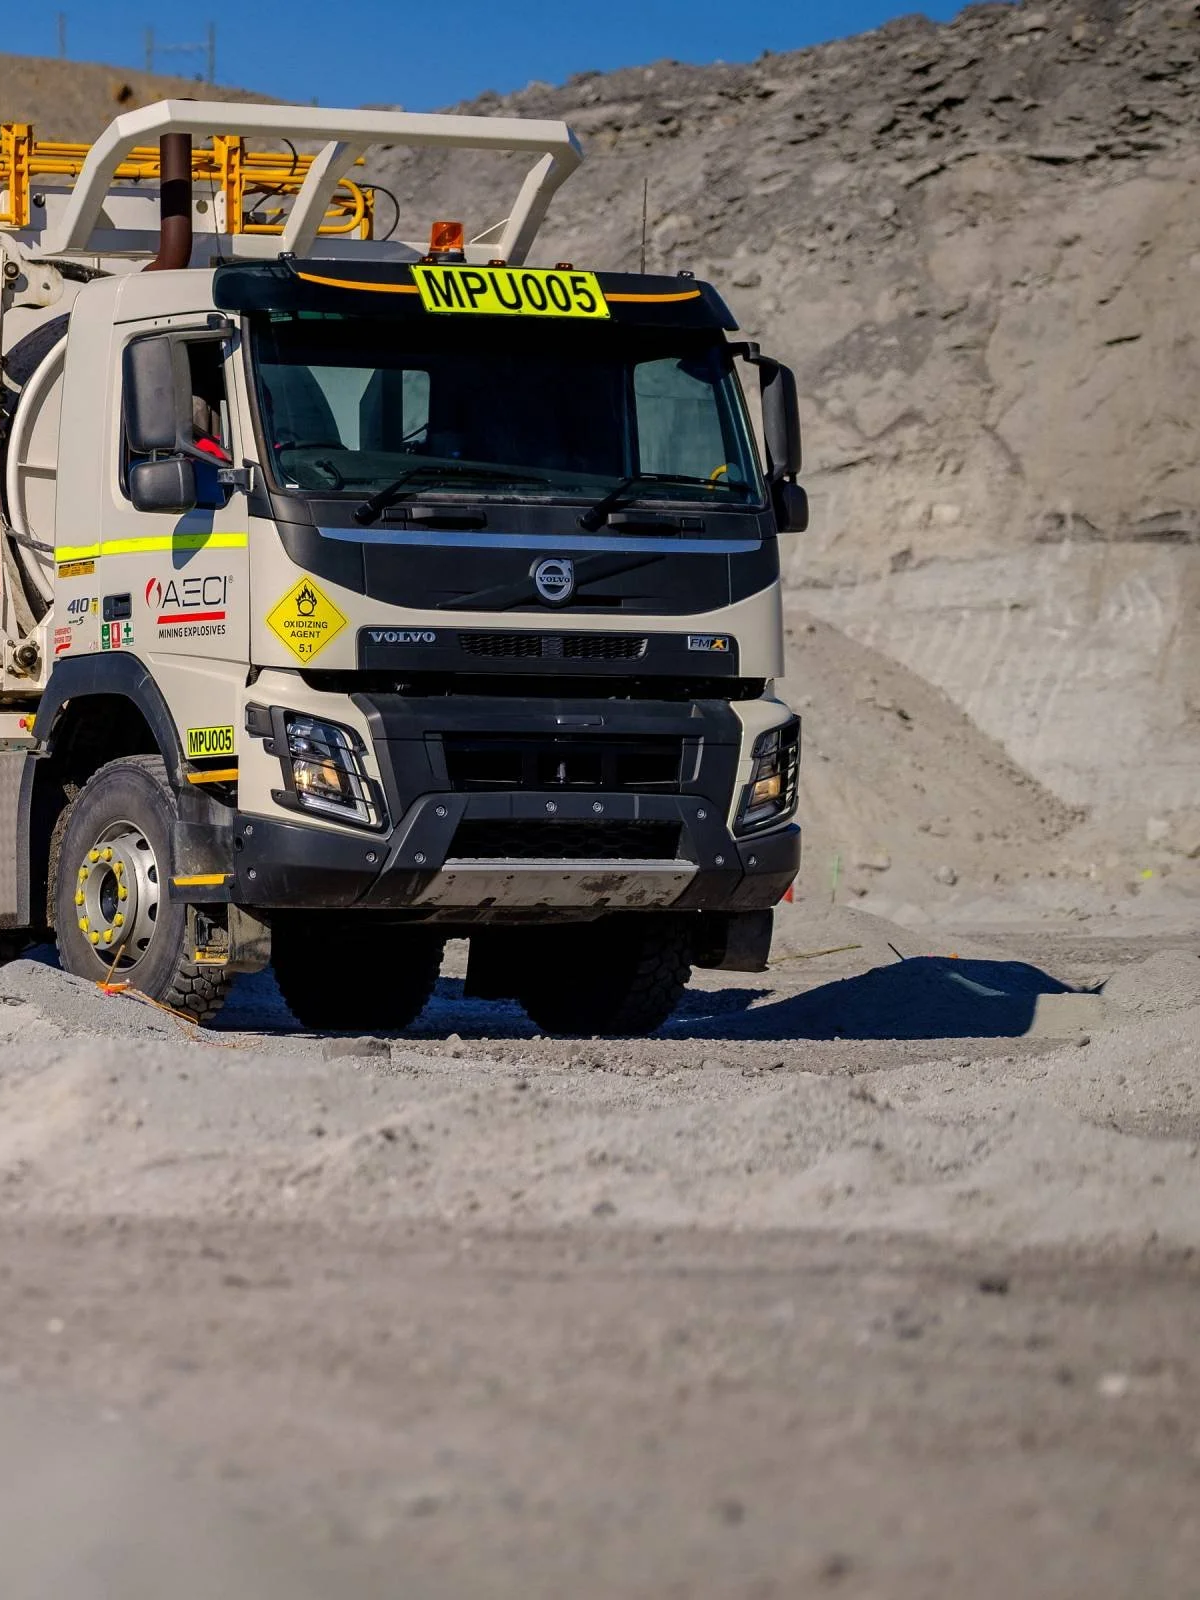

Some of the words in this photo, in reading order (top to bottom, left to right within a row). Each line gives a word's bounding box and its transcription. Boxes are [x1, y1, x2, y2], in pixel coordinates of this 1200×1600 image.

[422, 270, 597, 313] MPU005
[539, 576, 571, 584] VOLVO
[161, 575, 228, 609] AECI
[67, 597, 89, 615] 410
[283, 620, 328, 629] OXIDIZING
[158, 627, 183, 639] MINING
[184, 624, 226, 638] EXPLOSIVES
[290, 630, 321, 639] AGENT
[368, 631, 437, 643] VOLVO
[299, 643, 313, 653] 5.1
[690, 637, 727, 650] FMX
[189, 728, 232, 753] MPU005
